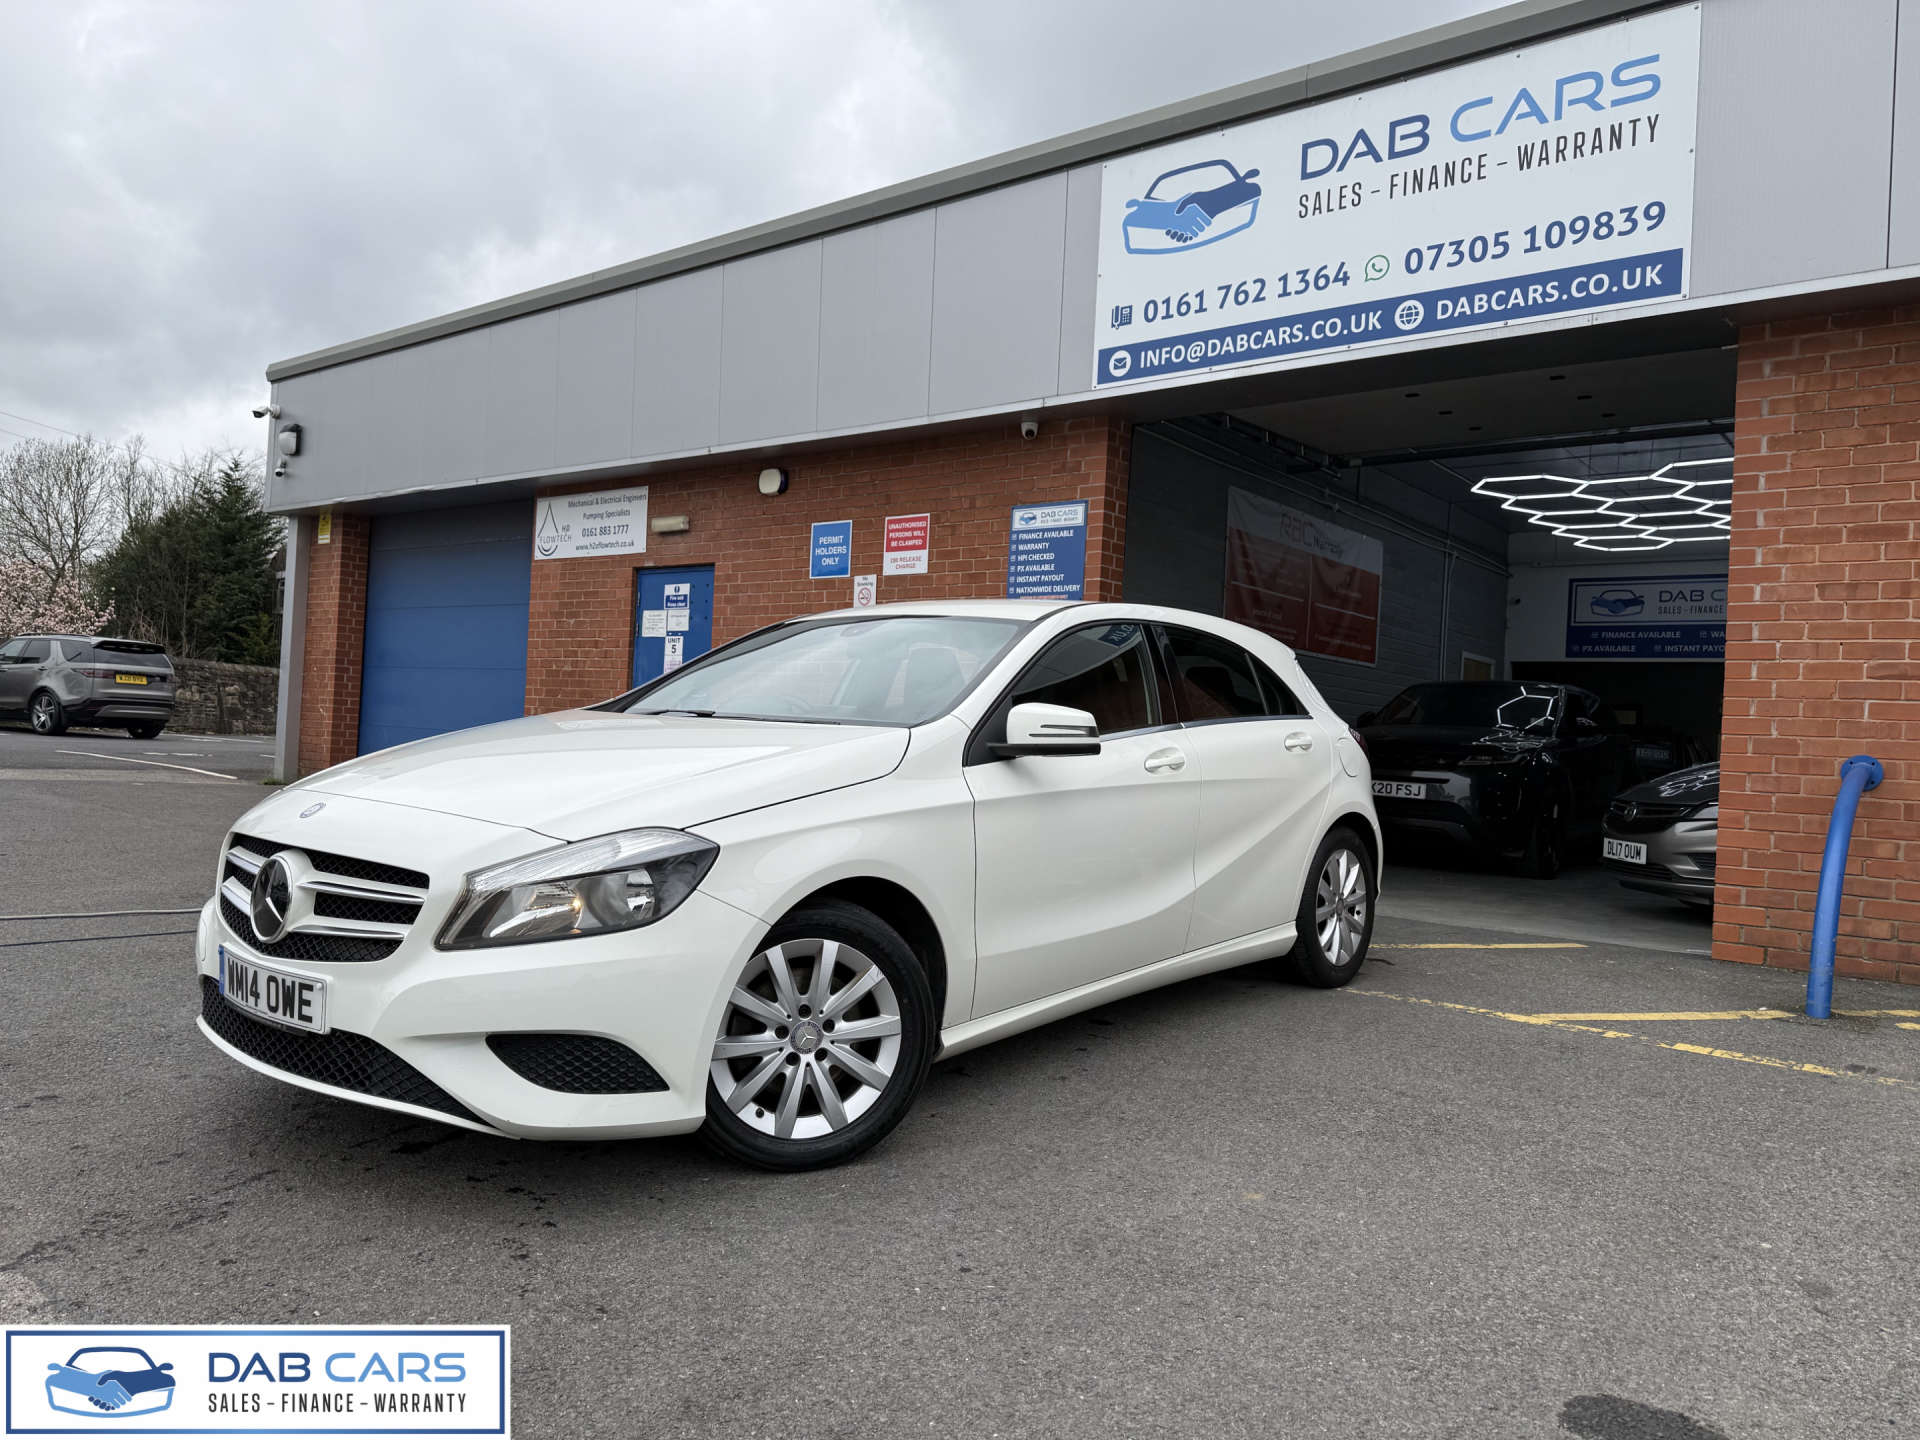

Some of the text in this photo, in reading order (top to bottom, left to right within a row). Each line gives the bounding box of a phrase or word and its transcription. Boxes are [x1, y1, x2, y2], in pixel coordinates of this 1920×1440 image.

[1300, 53, 1661, 181] DAB CARS
[1298, 181, 1364, 219] SALES
[1388, 153, 1488, 200] FINANCE
[1517, 114, 1660, 171] WARRANTY
[1143, 200, 1666, 323] 0161 762 1364 07305 109839
[1140, 263, 1663, 371] INFO@DABCARS.CO.UK DABCARS.CO.UK
[568, 498, 594, 508] Mechanical
[600, 496, 622, 505] Electrical
[622, 494, 647, 504] Engineers
[583, 509, 631, 520] Pumping Specialists
[1040, 510, 1056, 519] DAB
[582, 524, 629, 538] 0161 883 1777
[889, 530, 926, 538] PERSONS WILL
[1018, 530, 1074, 540] FINANCE AVAILABLE
[540, 534, 572, 544] FLOWTECH
[819, 535, 844, 545] PERMIT
[899, 538, 923, 548] CLAMPED
[815, 545, 847, 556] HOLDERS
[1018, 542, 1050, 551] WARRANTY
[822, 556, 839, 566] ONLY
[1028, 552, 1055, 560] CHECKED
[1026, 564, 1055, 572] AVAILABLE
[1041, 574, 1064, 582] PAYOUT
[1016, 584, 1080, 594] NATIONWIDE DELIVERY
[1658, 590, 1705, 603] DAB
[1658, 606, 1682, 616] SALES
[1690, 605, 1724, 614] FINANCE
[1638, 630, 1680, 638] AVAILABLE
[671, 644, 676, 654] 5
[1664, 645, 1700, 653] INSTANT
[1396, 784, 1421, 796] FSJ
[1608, 840, 1642, 860] DL17 OUM
[266, 975, 314, 1024] OWE
